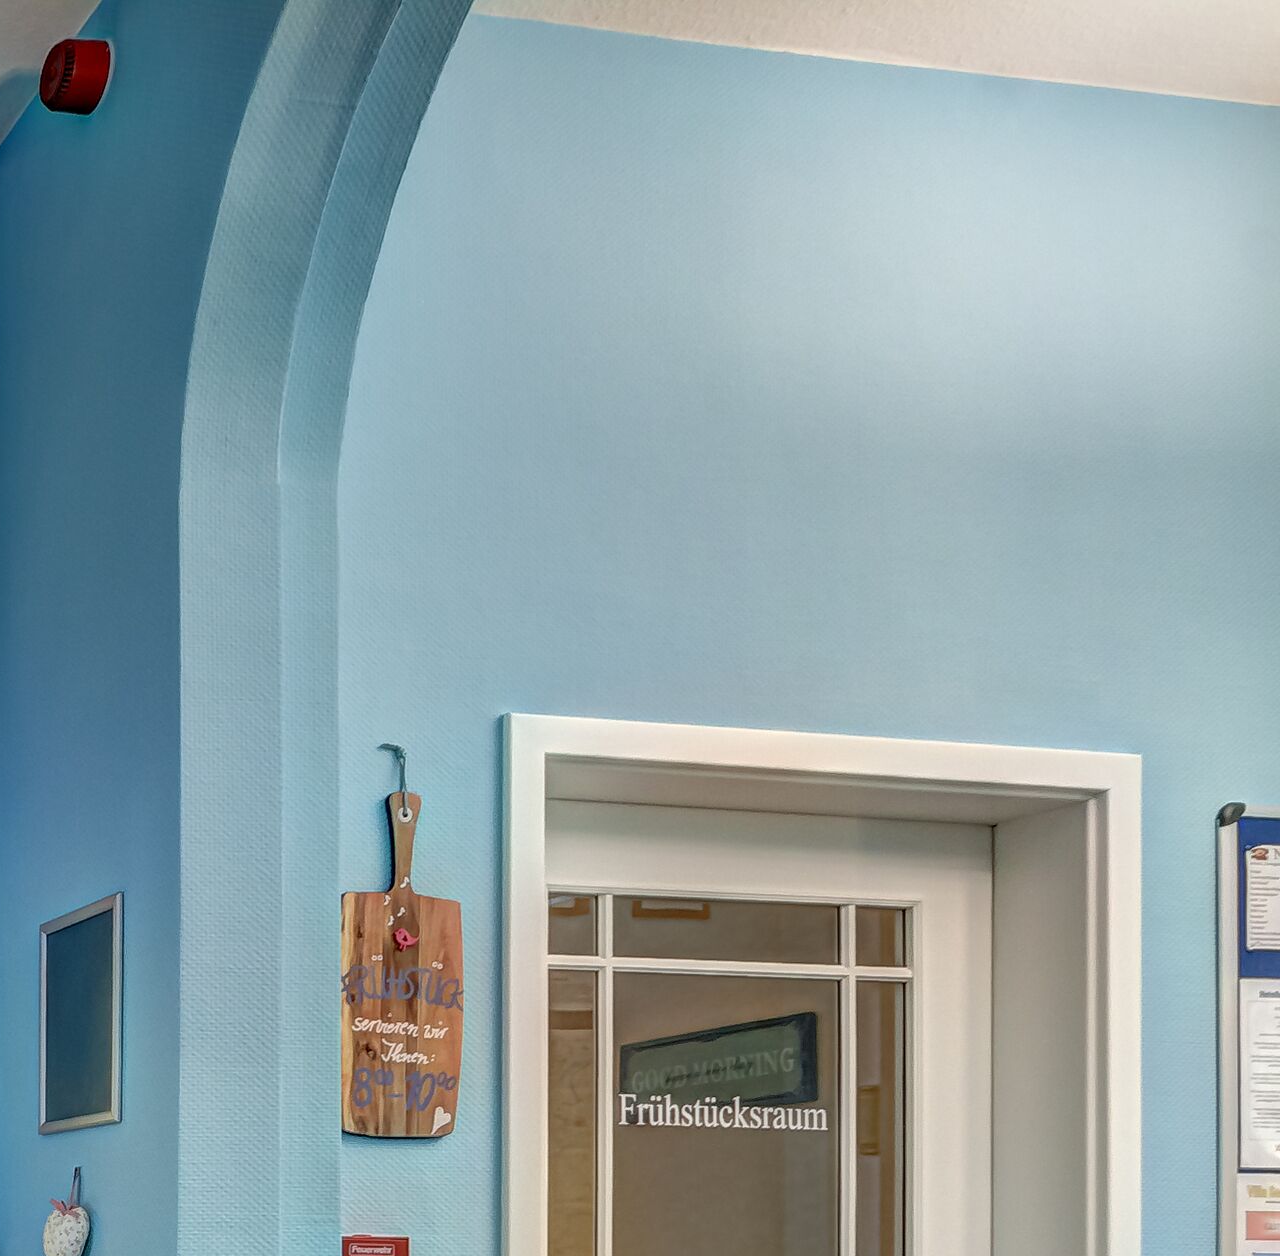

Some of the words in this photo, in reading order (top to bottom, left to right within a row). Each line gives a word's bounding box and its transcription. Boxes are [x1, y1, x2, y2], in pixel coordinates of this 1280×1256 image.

[352, 1013, 418, 1036] servieren
[424, 1021, 448, 1039] wir
[381, 1038, 435, 1065] Ihnen:
[692, 1047, 795, 1086] MORNING
[618, 1094, 828, 1131] Frühstücksraum
